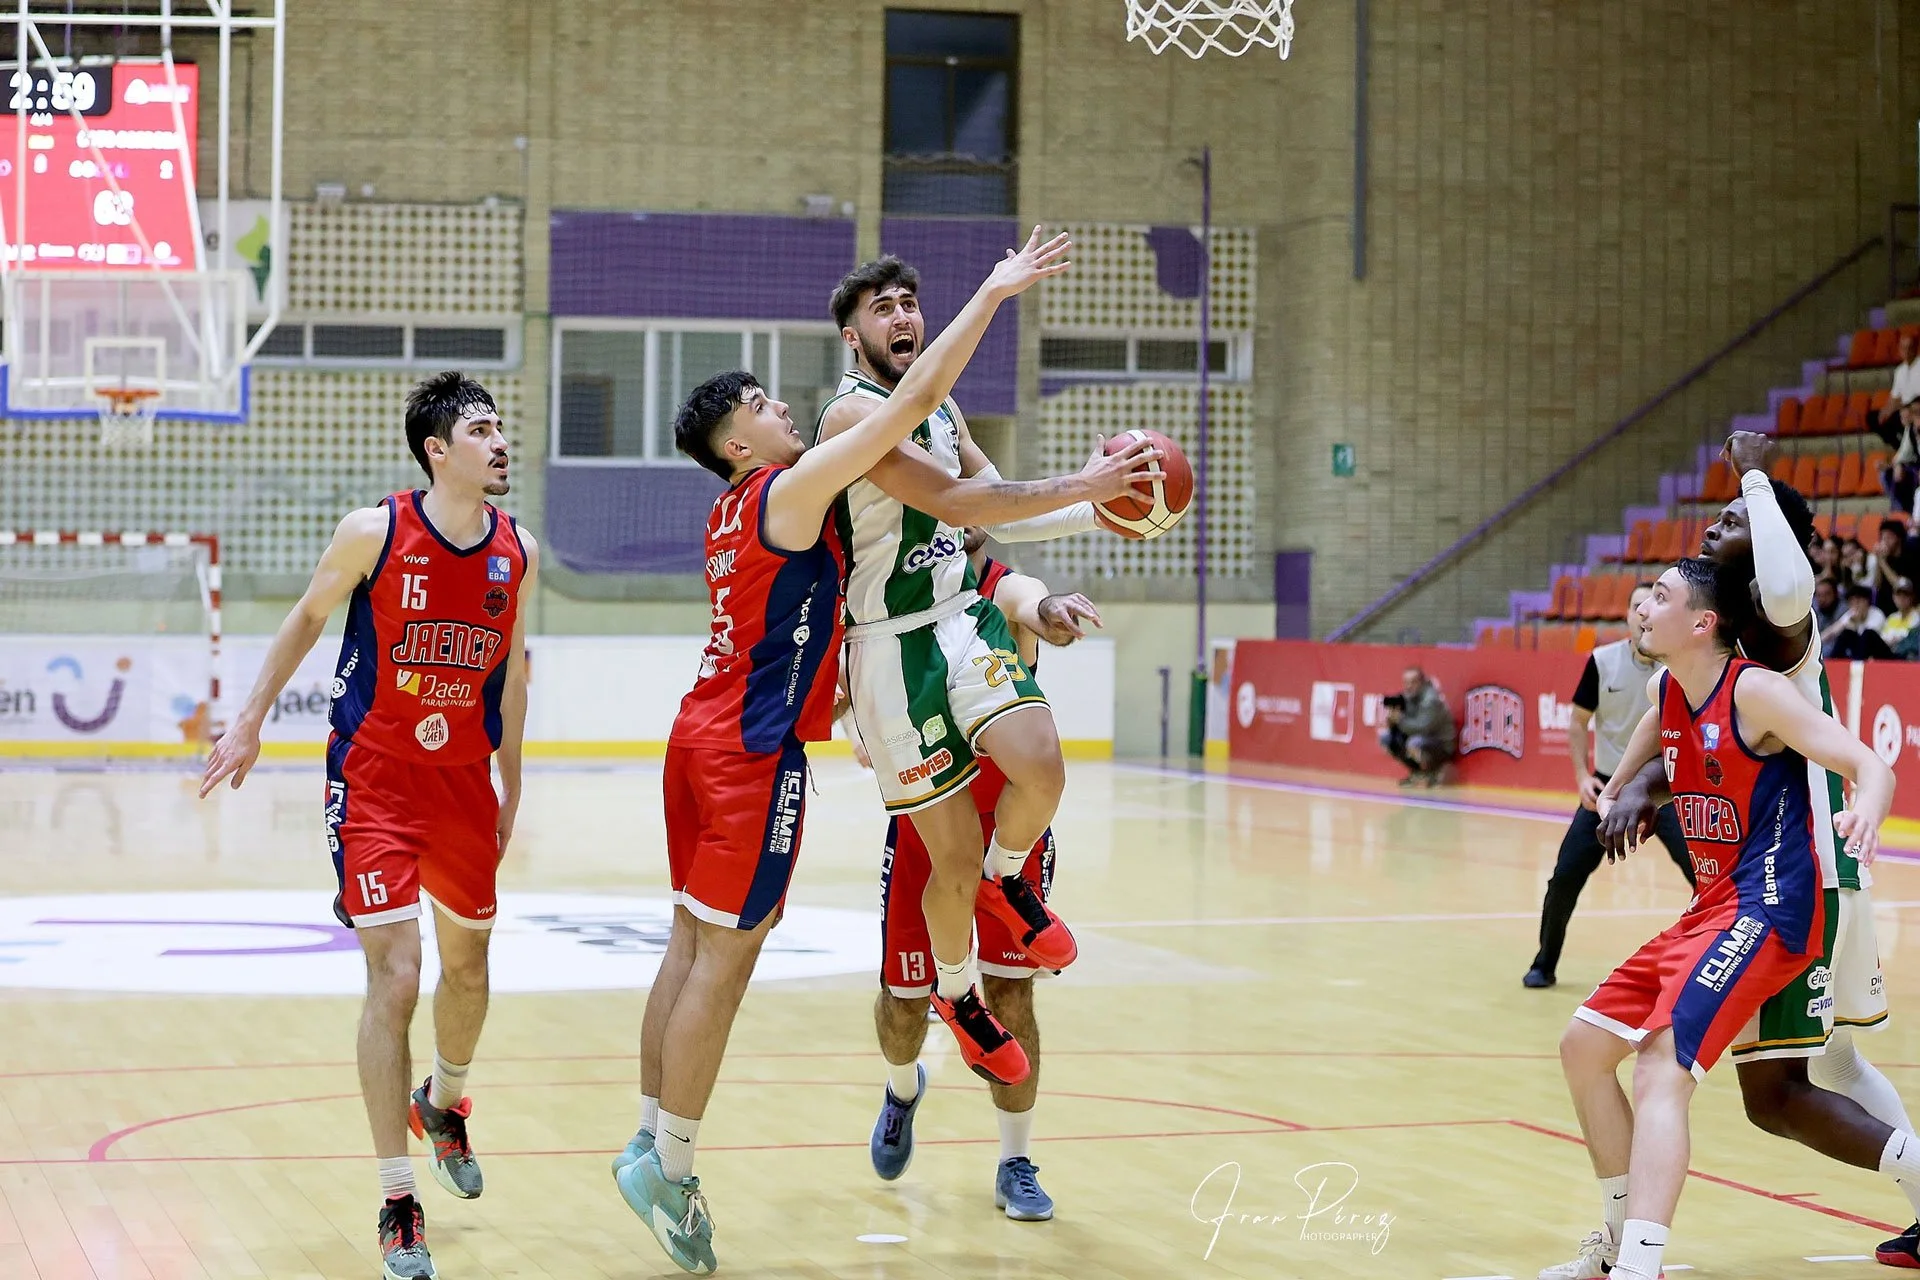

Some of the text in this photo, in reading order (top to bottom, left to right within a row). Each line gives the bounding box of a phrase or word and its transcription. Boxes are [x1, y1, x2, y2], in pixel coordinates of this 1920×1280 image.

[403, 554, 430, 565] vive
[488, 572, 505, 581] EBA
[401, 573, 429, 610] 15
[422, 674, 471, 699] Jaén
[769, 770, 791, 853] CLIMBING CENTER
[356, 870, 389, 907] 15
[1763, 855, 1779, 906] Blanca
[898, 950, 926, 982] 13
[1002, 951, 1026, 961] vive
[1713, 921, 1765, 992] CLIMBING CENTER
